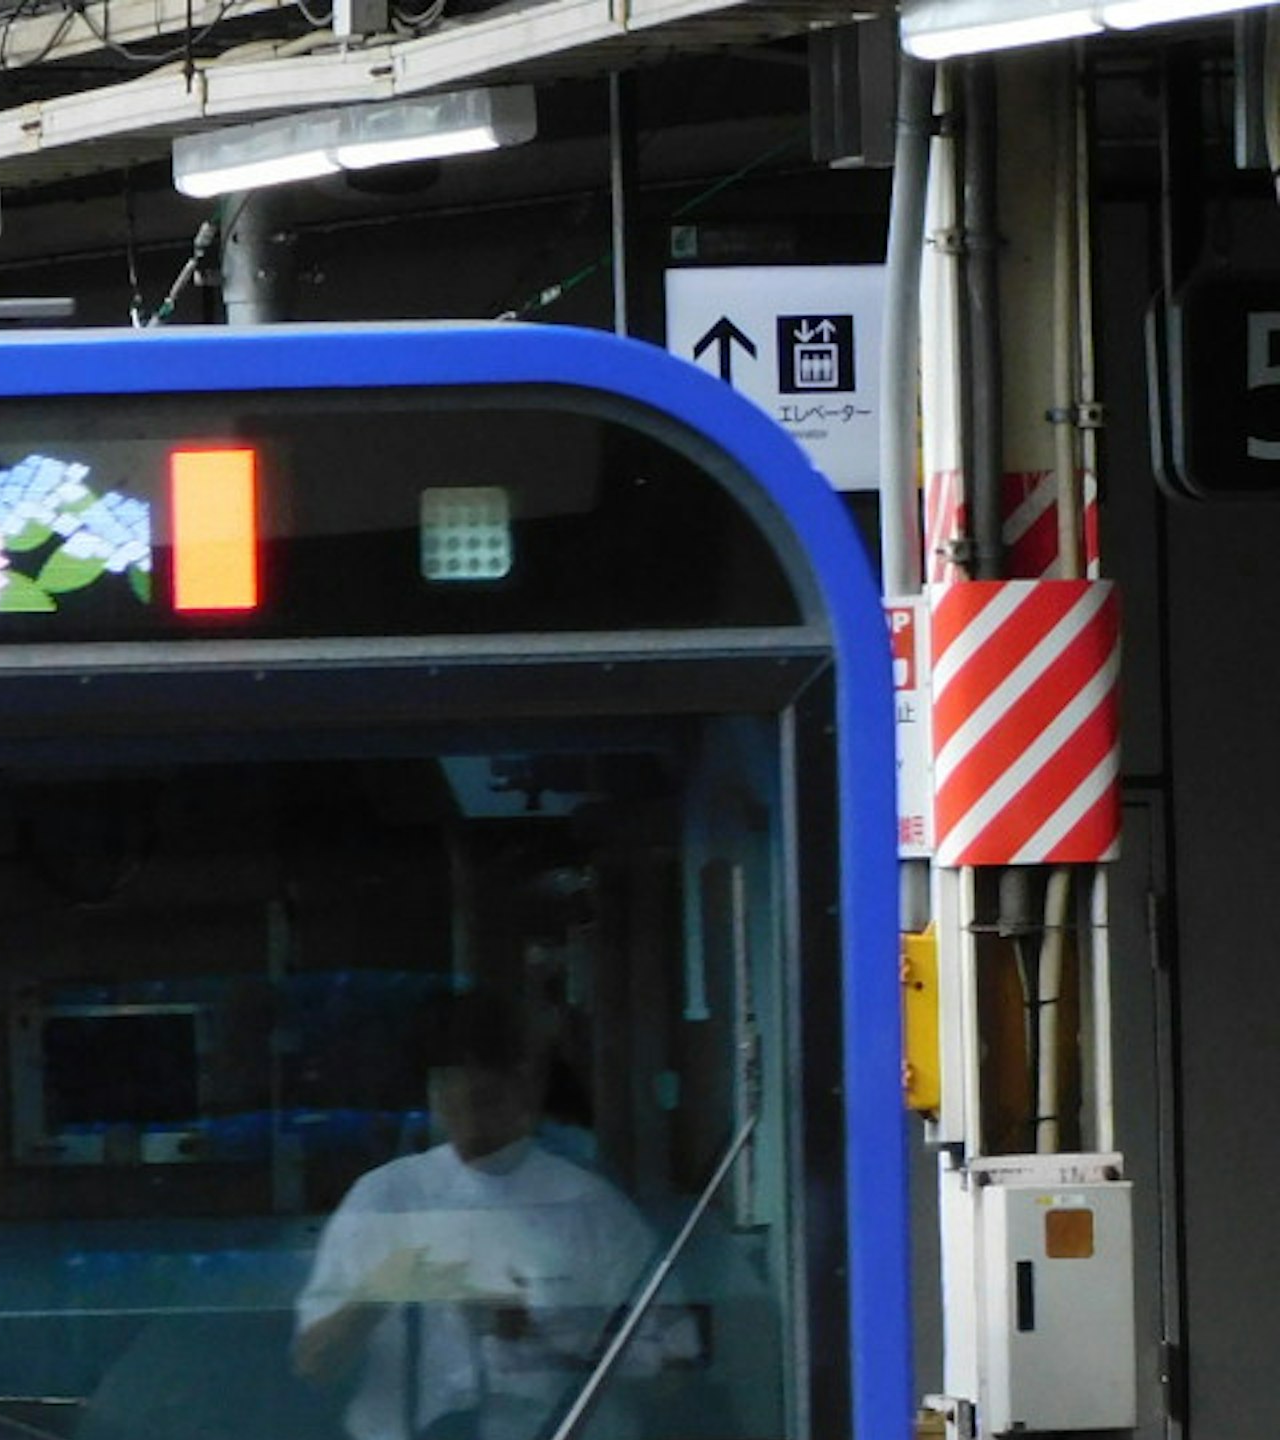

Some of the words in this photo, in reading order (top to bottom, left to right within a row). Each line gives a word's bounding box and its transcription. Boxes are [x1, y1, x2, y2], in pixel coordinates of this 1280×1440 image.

[778, 404, 873, 422] エレベーター
